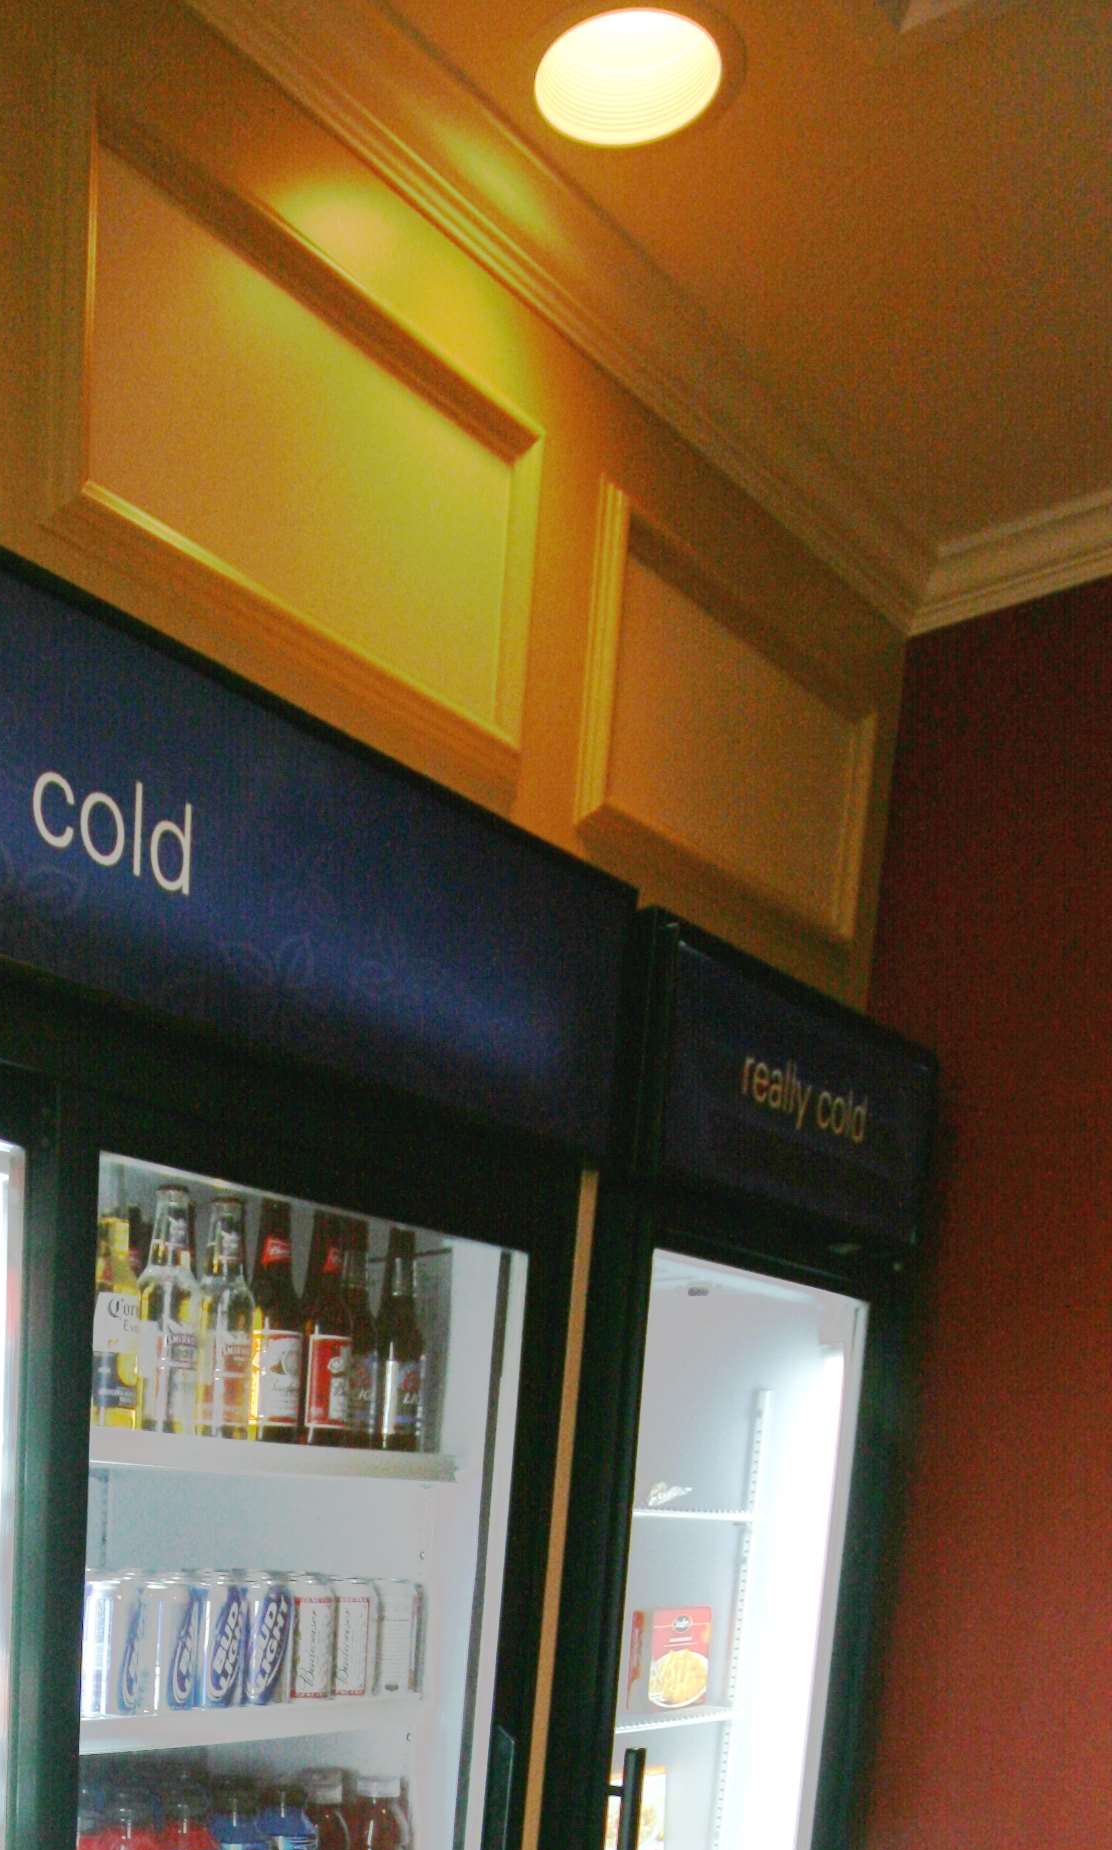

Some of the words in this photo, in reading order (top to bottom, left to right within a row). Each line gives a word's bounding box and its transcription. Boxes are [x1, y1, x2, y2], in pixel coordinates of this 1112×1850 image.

[32, 771, 192, 896] cold
[741, 1056, 812, 1130] really
[817, 1089, 868, 1144] cold
